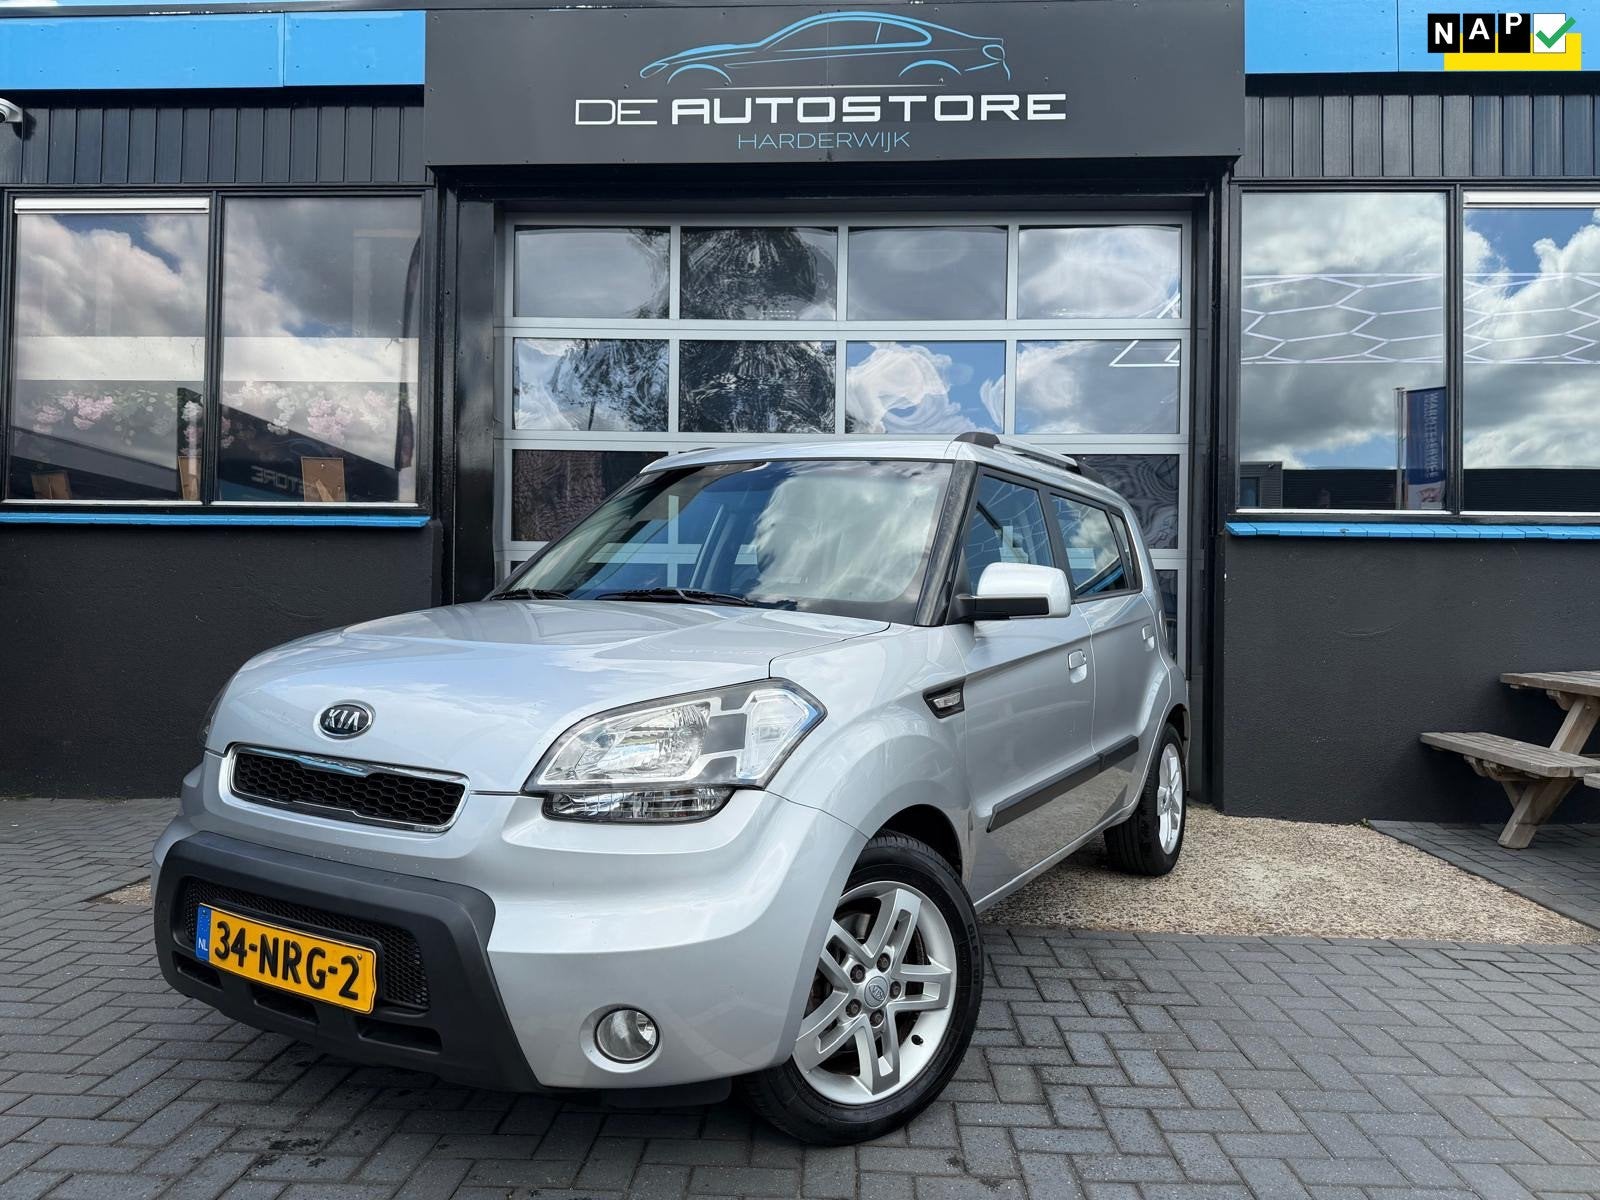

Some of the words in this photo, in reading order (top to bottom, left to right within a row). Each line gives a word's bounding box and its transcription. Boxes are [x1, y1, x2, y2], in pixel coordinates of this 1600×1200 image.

[574, 98, 658, 126] DE
[671, 93, 1067, 126] AUTOSTORE
[738, 131, 911, 153] HARDERWIJK
[325, 708, 361, 731] KIA
[198, 936, 208, 952] NL
[214, 920, 360, 1001] 34-NRG-2
